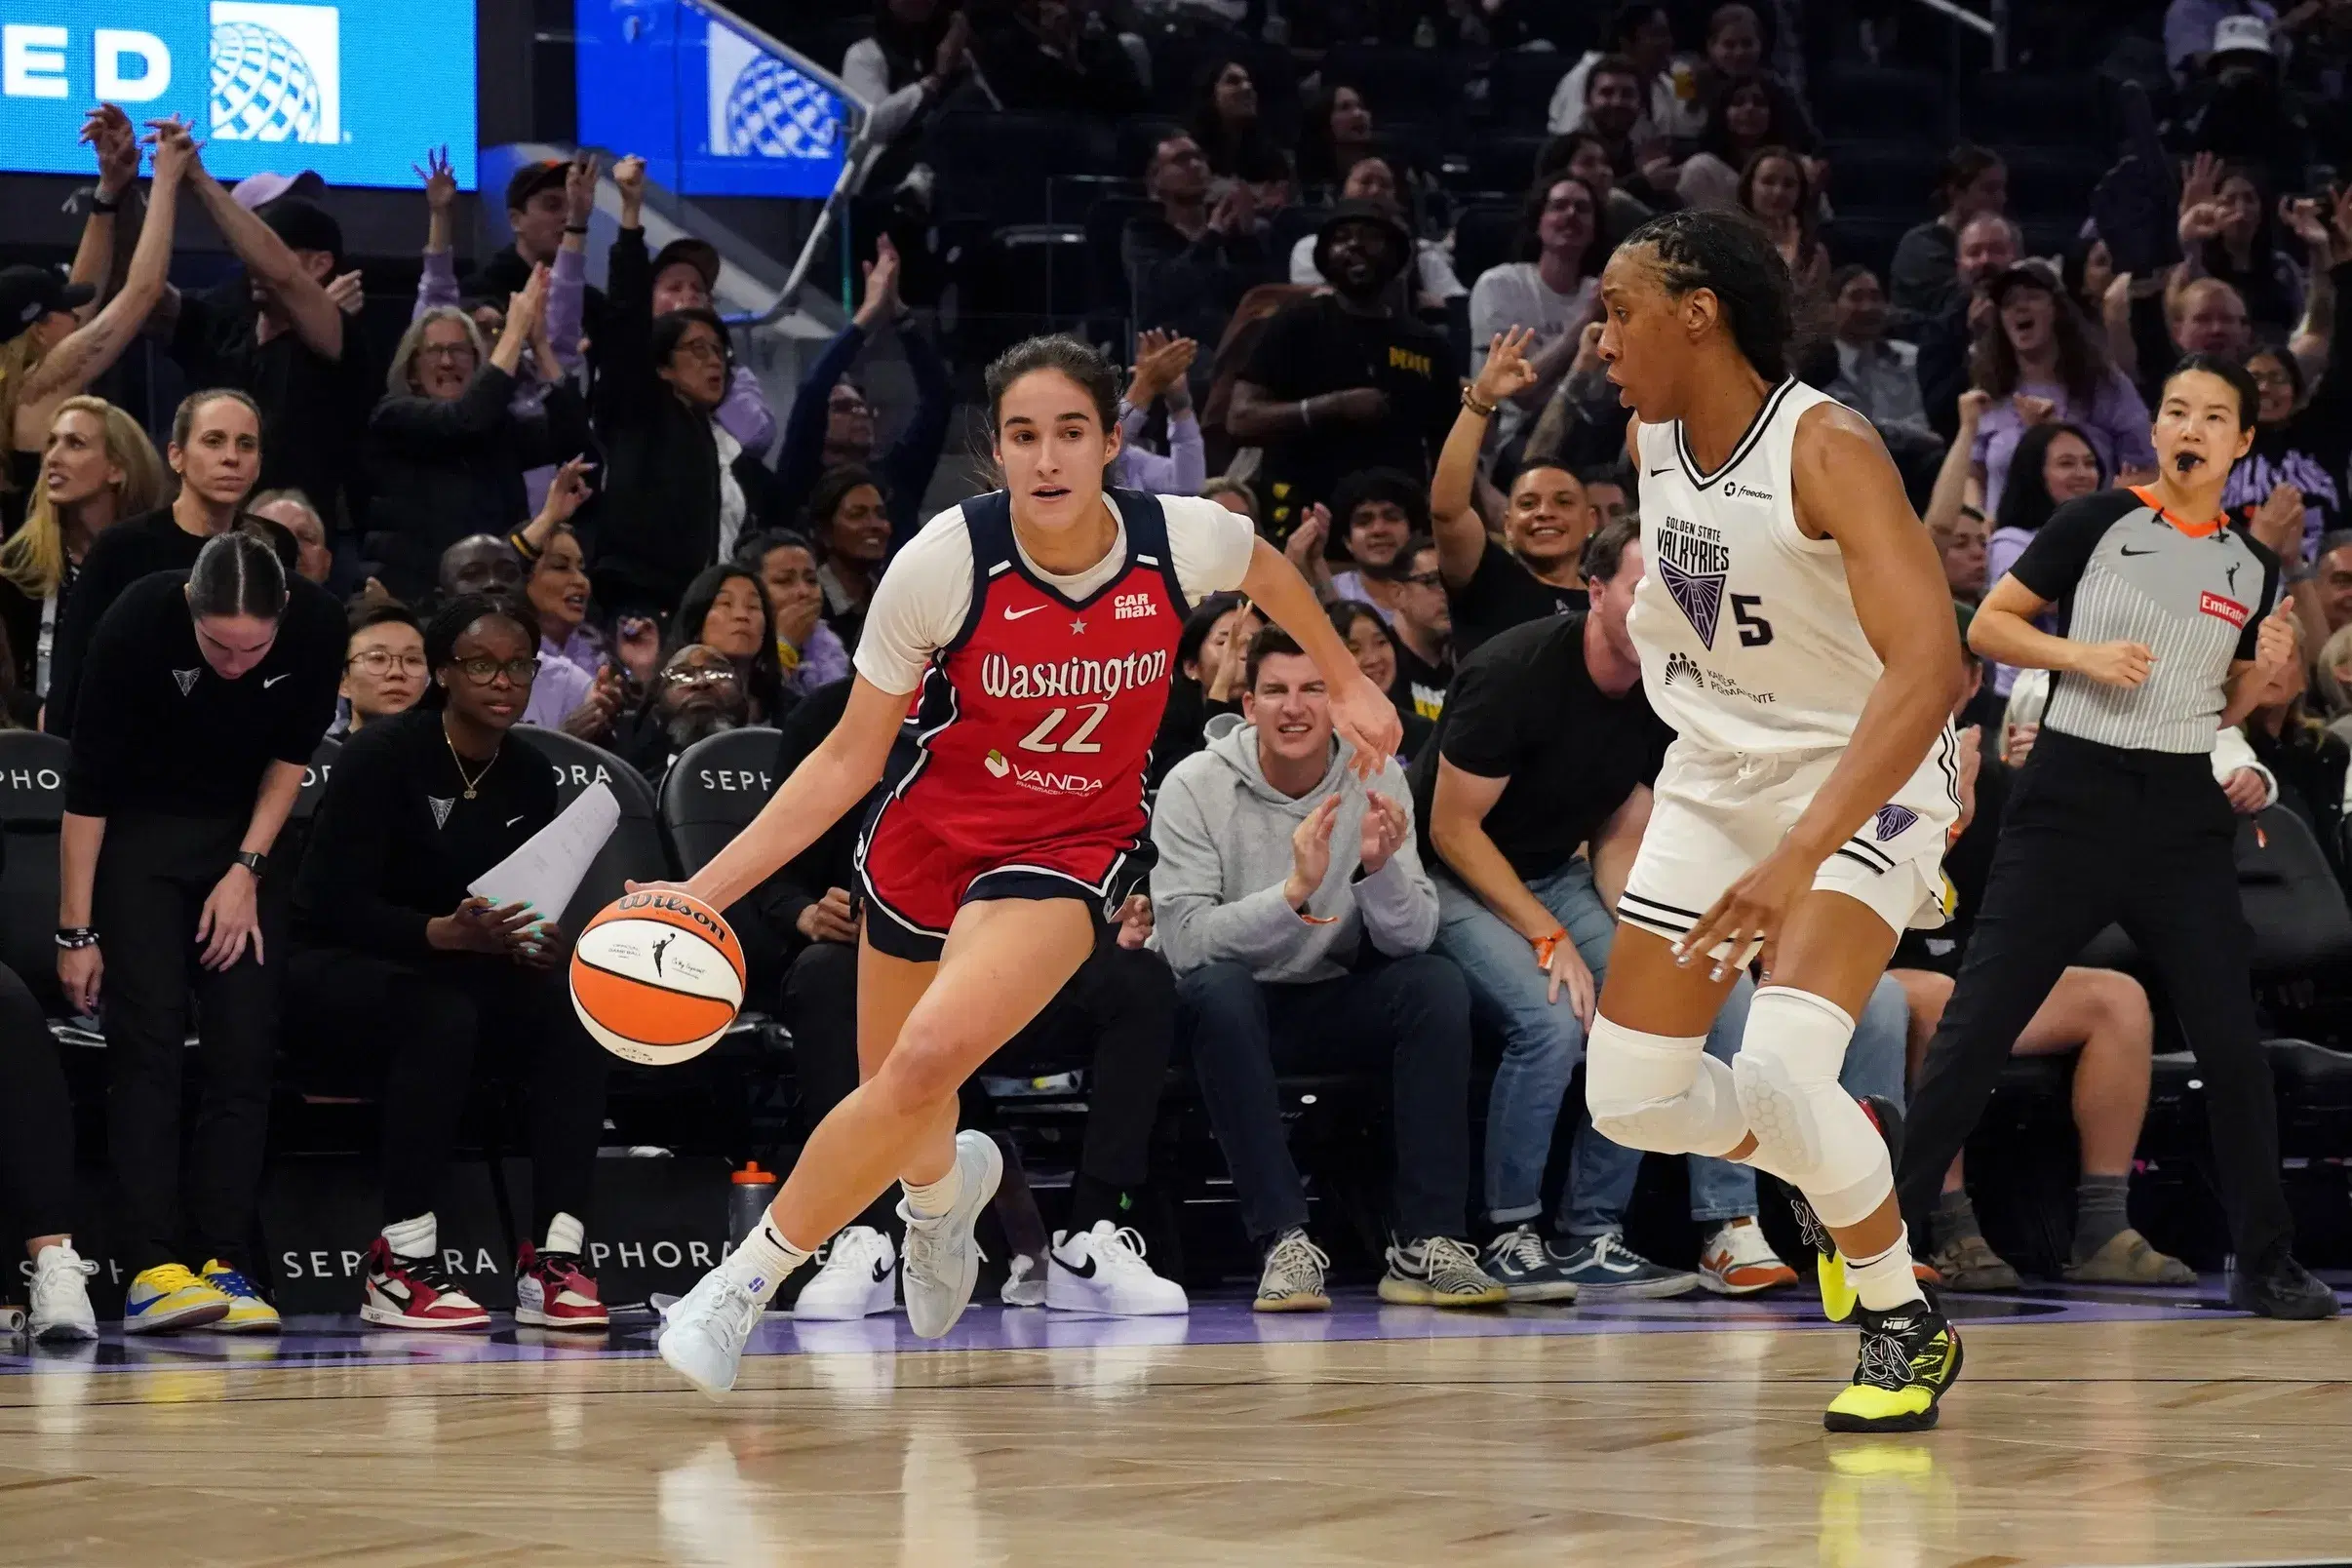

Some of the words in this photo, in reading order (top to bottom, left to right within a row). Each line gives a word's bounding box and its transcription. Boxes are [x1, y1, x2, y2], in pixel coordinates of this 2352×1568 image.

[4, 24, 172, 101] ED
[1737, 486, 1773, 500] freedom
[1666, 516, 1696, 535] GOLDEN
[1698, 526, 1721, 542] STATE
[1658, 527, 1730, 573] VALKYRIES
[1114, 593, 1149, 608] CAR
[1115, 604, 1157, 619] max
[2202, 595, 2244, 624] Emirate
[1730, 593, 1775, 647] 5
[981, 648, 1166, 701] Washington
[1018, 703, 1109, 753] 22
[1012, 764, 1103, 792] VANDA
[617, 893, 726, 944] Wilson
[283, 1248, 499, 1278] SEPRA
